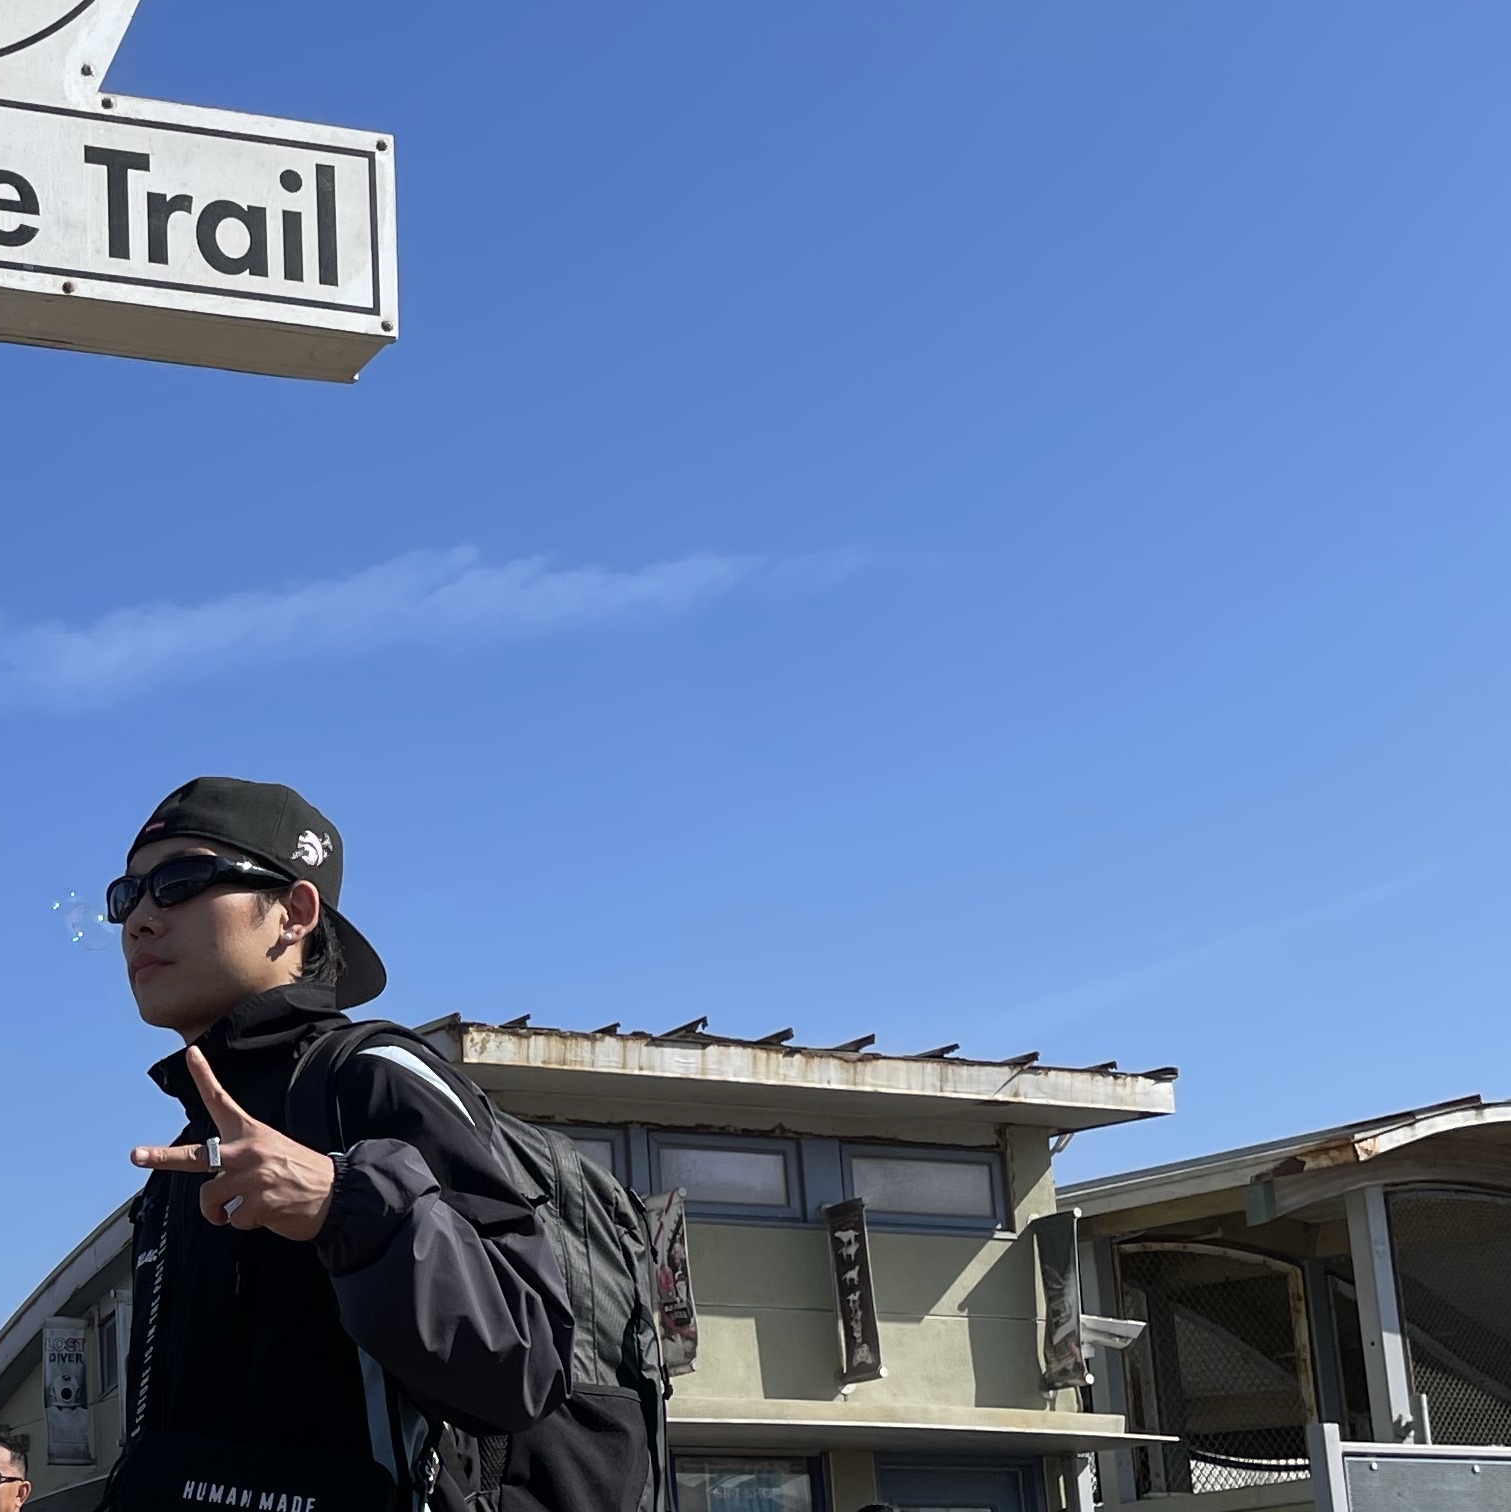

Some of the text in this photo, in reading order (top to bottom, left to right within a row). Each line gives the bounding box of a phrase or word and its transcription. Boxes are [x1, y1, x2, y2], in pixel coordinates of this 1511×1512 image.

[83, 144, 341, 288] Trail
[44, 1337, 87, 1352] LOST
[49, 1352, 85, 1363] DIVER
[183, 1480, 252, 1508] HUMAN
